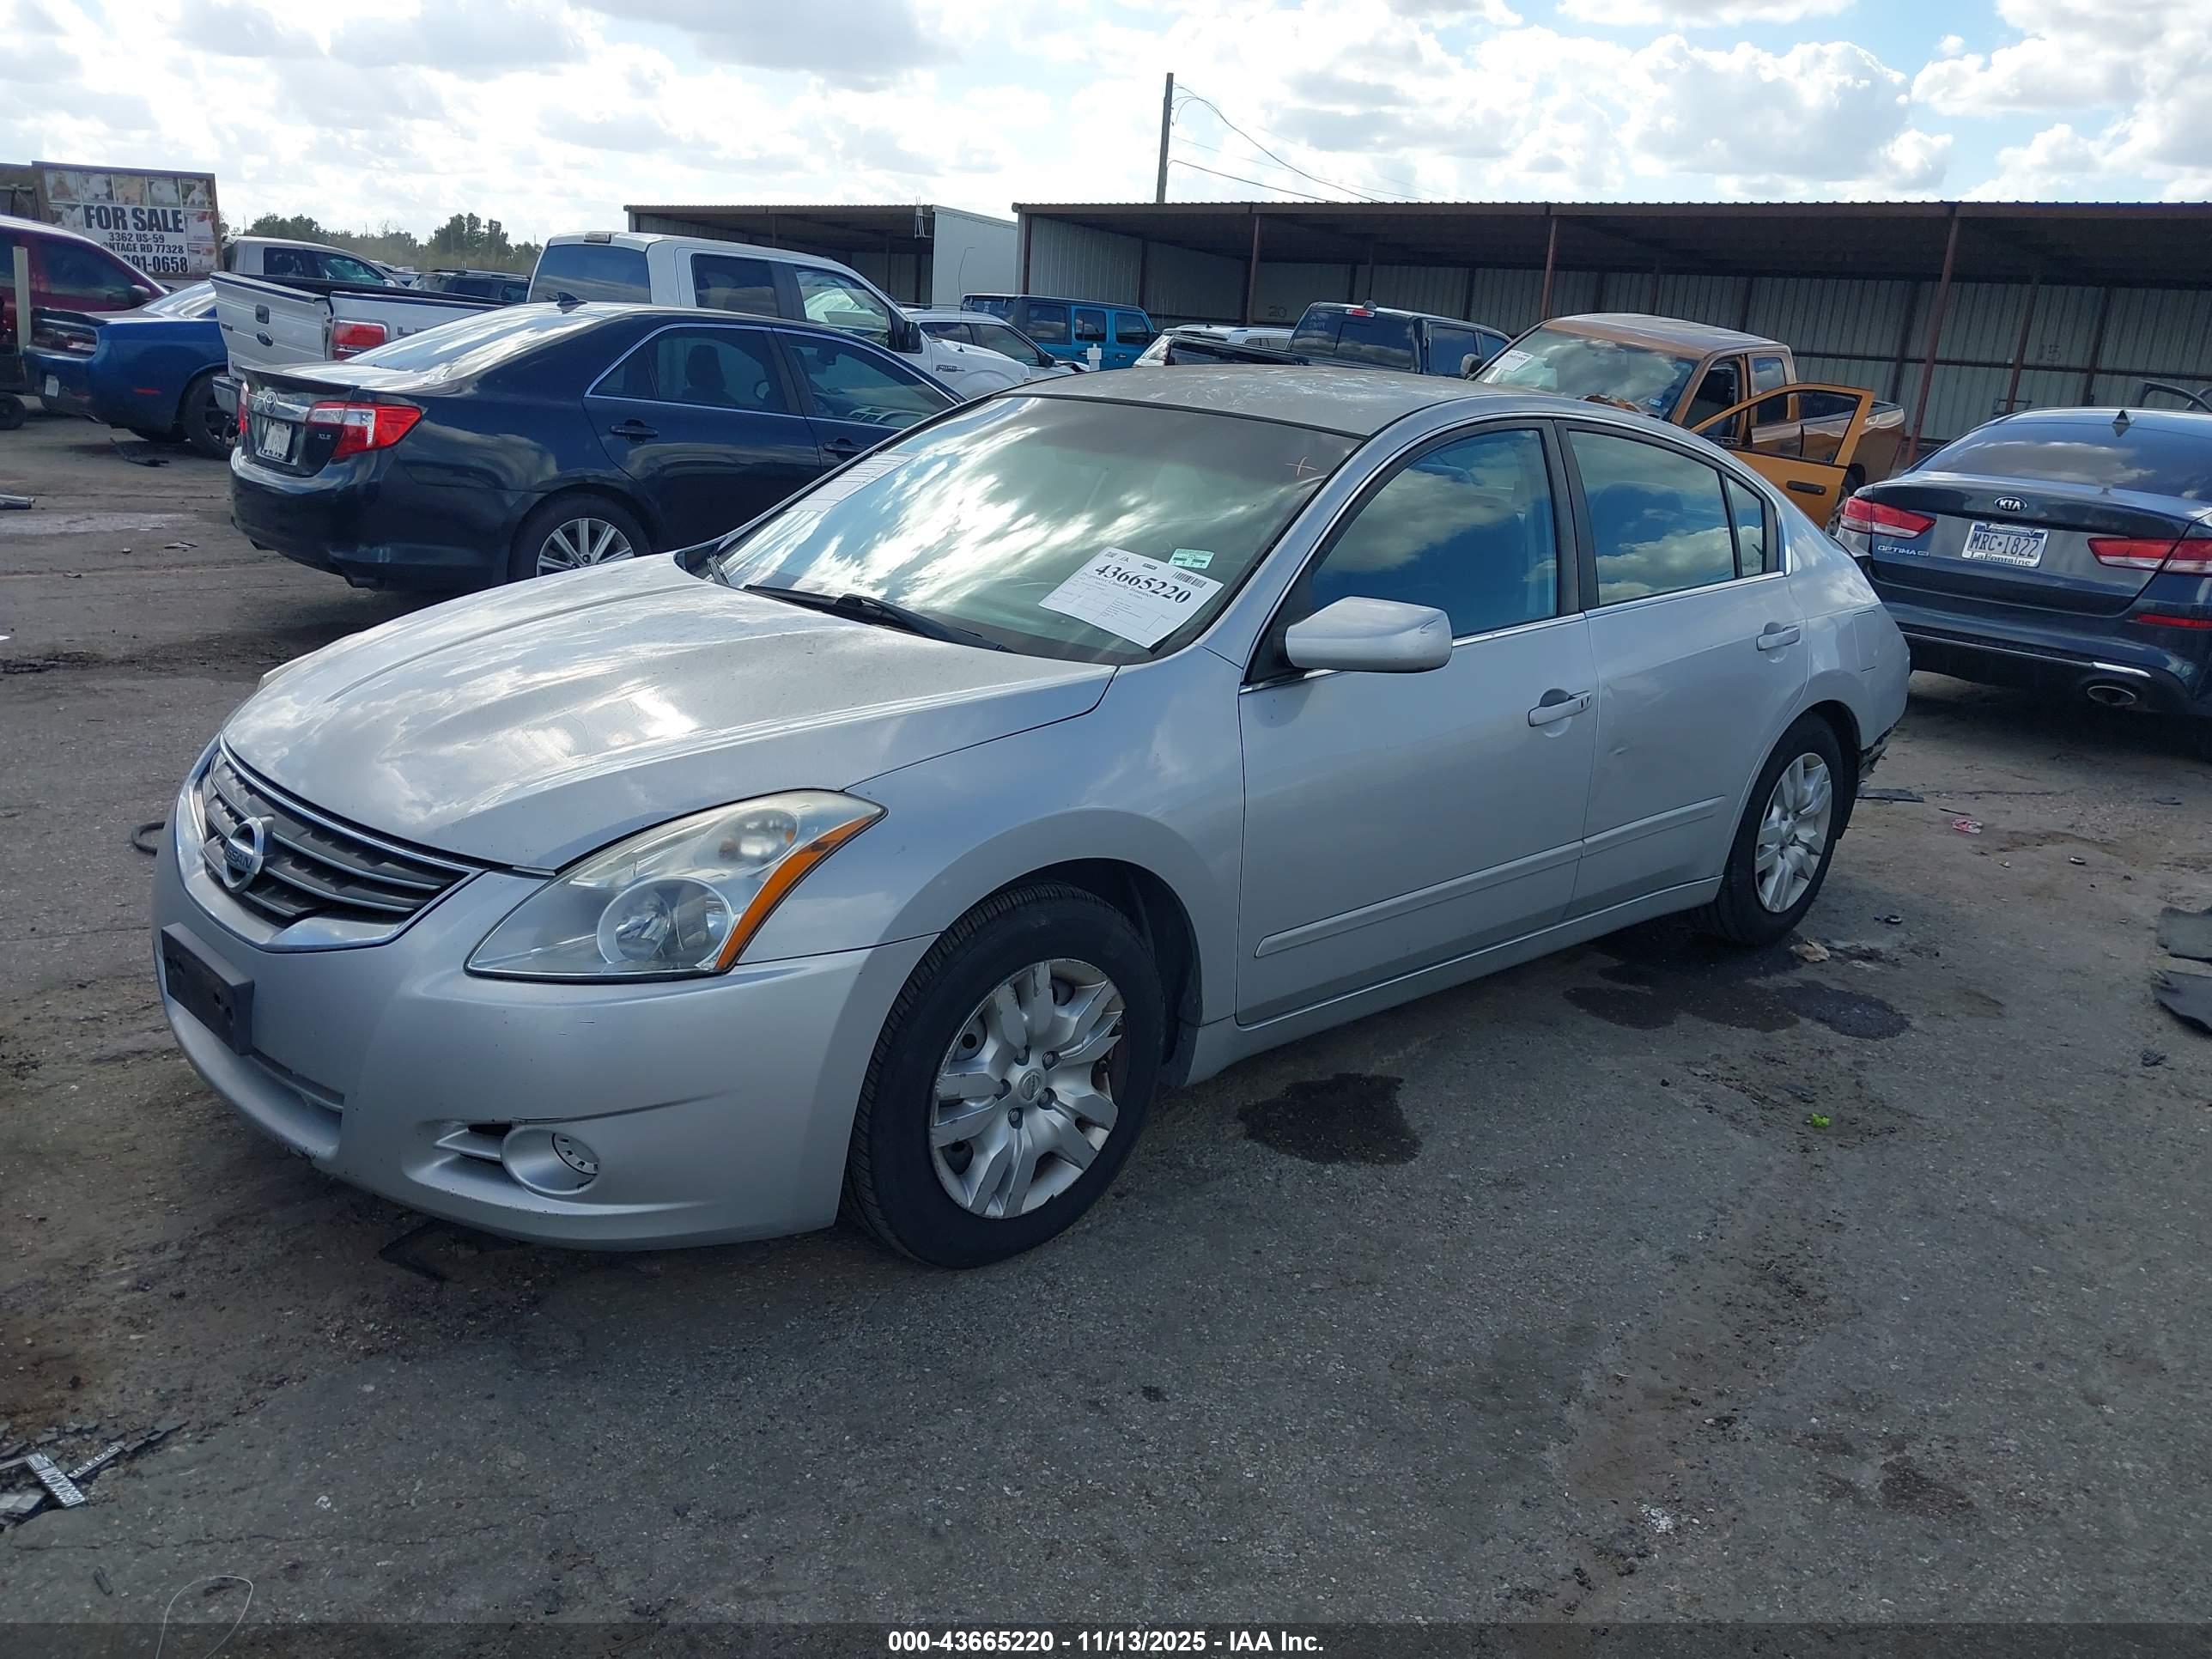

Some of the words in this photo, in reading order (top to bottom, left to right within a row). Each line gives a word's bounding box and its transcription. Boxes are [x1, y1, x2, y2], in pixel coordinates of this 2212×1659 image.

[83, 204, 128, 231] FOR
[131, 207, 184, 234] SALE
[108, 232, 133, 242] 3362
[136, 233, 165, 243] US-59
[140, 244, 153, 253] RD
[155, 244, 184, 254] 77328
[1999, 500, 2021, 511] KIA
[1095, 564, 1192, 604] 43665220
